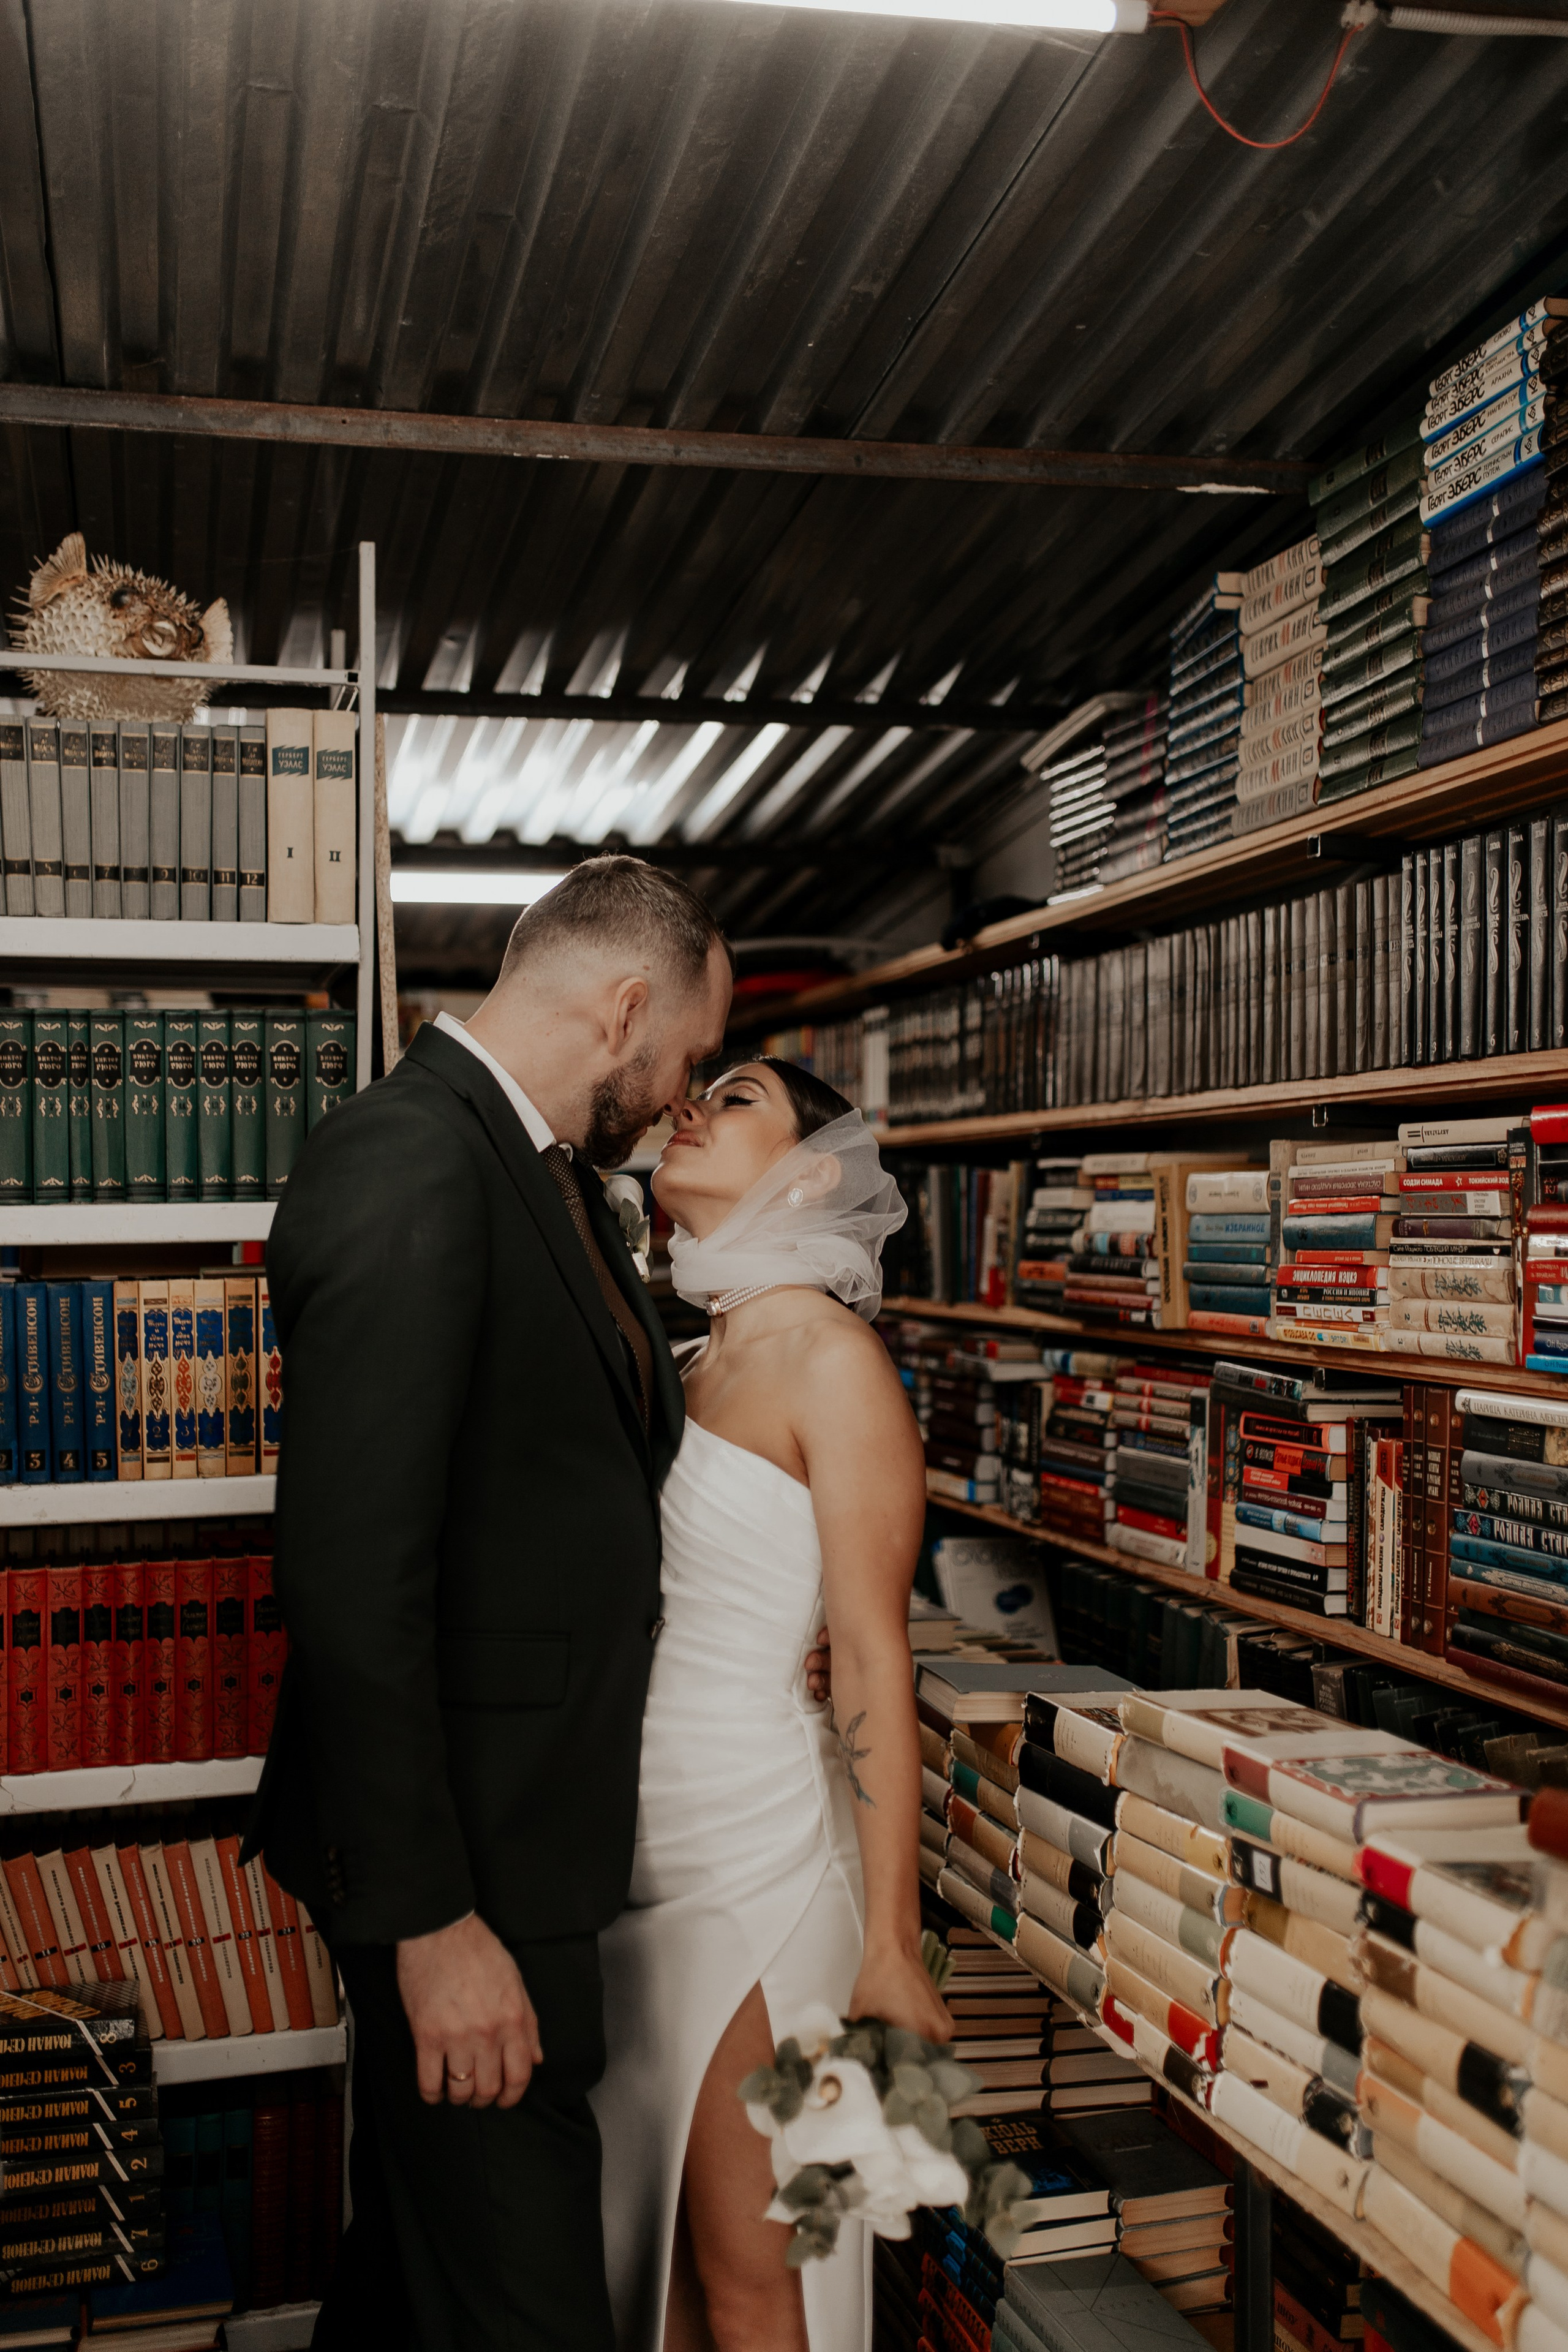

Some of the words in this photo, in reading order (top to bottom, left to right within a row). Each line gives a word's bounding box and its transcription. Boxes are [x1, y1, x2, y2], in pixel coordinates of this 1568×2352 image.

[1494, 326, 1511, 343] СЛОВО
[1491, 368, 1513, 387] АРАХНА
[1449, 382, 1485, 417] ЭБЕРС
[1487, 393, 1518, 418] ИМПЕРАТОР
[1452, 410, 1486, 446] ЭБЕРС
[1491, 424, 1513, 445] СЕРАПИС
[1453, 439, 1487, 471] ЭБЕРС
[1483, 450, 1512, 472] ТЕРНИСТЫМ
[1482, 466, 1501, 480] ПУТЕМ
[1448, 466, 1481, 500] ЭБЕРС
[287, 846, 294, 859] I
[1489, 842, 1501, 852] ДЮМА
[329, 850, 341, 862] II
[104, 867, 110, 878] 7
[189, 870, 203, 880] 10
[221, 872, 230, 883] 11
[247, 874, 257, 884] 12
[1513, 1030, 1518, 1042] 7
[1534, 1028, 1539, 1041] 8
[1558, 1025, 1564, 1037] 9
[1433, 1042, 1436, 1052] 3
[1448, 1040, 1452, 1051] 4
[1466, 1036, 1469, 1048] 5
[1490, 1034, 1495, 1046] 6
[1404, 1044, 1408, 1055] 1
[1417, 1042, 1422, 1054] 2
[1469, 1175, 1498, 1185] ТОКИЙСКИЙ
[1225, 1221, 1265, 1233] ИЗБРАННОЕ
[1460, 1257, 1492, 1265] ВЕРТИКАЛИ
[1293, 1270, 1336, 1284] ЭНЦИКЛОПЕДИЯ
[1338, 1271, 1357, 1284] НЭЦКЭ
[1474, 1402, 1501, 1415] ЦАРИЦА
[1504, 1408, 1538, 1421] КАТЕРИНА
[153, 1426, 162, 1438] 2
[181, 1425, 190, 1437] 3
[30, 1453, 41, 1469] 3
[63, 1453, 75, 1469] 4
[96, 1452, 107, 1469] 5
[1507, 1494, 1543, 1520] РОДНАЯ
[1493, 1519, 1533, 1548] РОДНАЯ
[192, 1937, 202, 1946] 20
[28, 2034, 72, 2052] ЮЛИАН
[99, 2032, 116, 2044] 8
[44, 2065, 88, 2084] ЮЛИАН
[119, 2062, 136, 2073] 3
[45, 2100, 89, 2118] ЮЛИАН
[119, 2097, 137, 2109] 5
[44, 2132, 89, 2149] ЮЛИАН
[121, 2129, 138, 2142] 4
[992, 2136, 1044, 2155] ВЕРН
[130, 2157, 148, 2171] 2
[55, 2162, 99, 2181] ЮЛИАН
[129, 2195, 145, 2203] 1
[52, 2198, 96, 2217] ЮЛИАН
[130, 2228, 149, 2240] 7
[58, 2231, 102, 2252] ЮЛИАН
[2, 2238, 55, 2260] СЕМЕНОВ
[141, 2258, 159, 2272] 6
[66, 2265, 111, 2285] ЮЛИАН
[11, 2272, 64, 2293] СЕМЕНОВ
